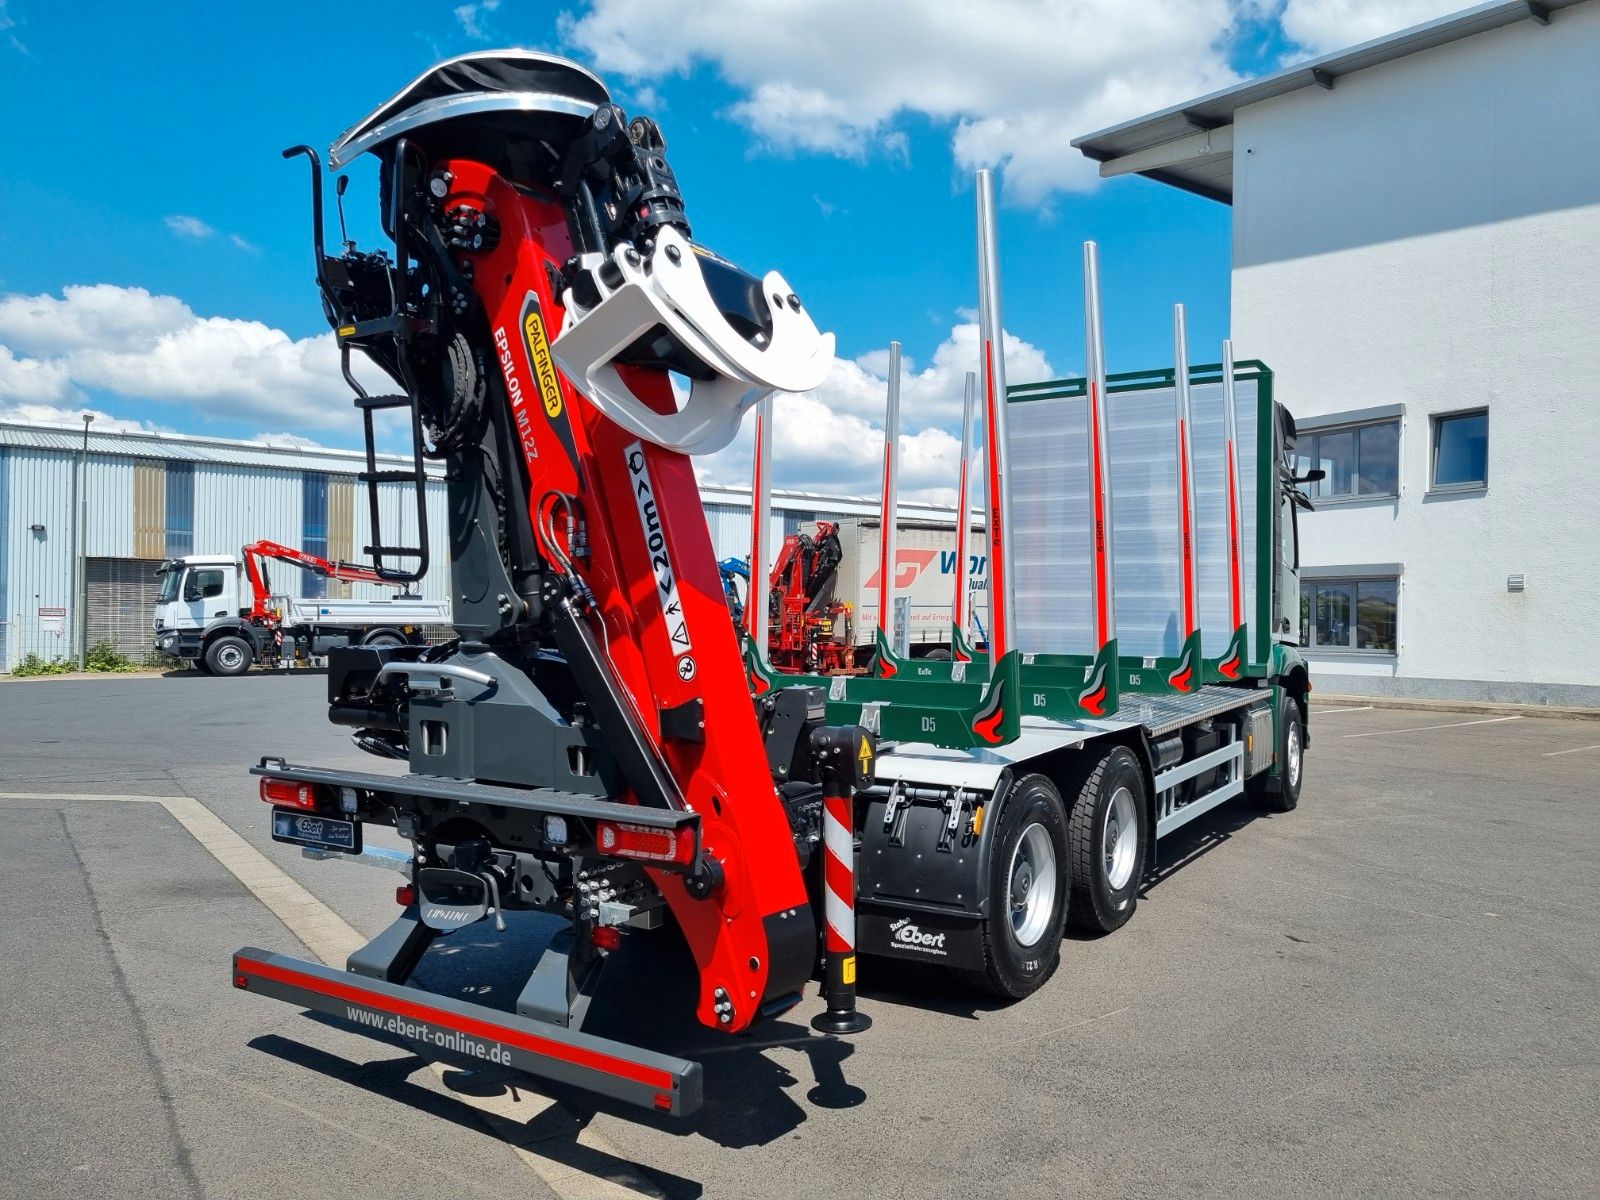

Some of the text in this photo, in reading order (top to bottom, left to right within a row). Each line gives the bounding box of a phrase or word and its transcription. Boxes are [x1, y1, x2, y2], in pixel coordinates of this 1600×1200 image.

[528, 318, 559, 411] PALFINGER
[494, 326, 539, 463] EPSILON M12Z
[1129, 674, 1141, 686] D5
[1033, 693, 1046, 707] D5
[921, 716, 936, 733] D5
[900, 925, 946, 948] Ebert
[346, 1005, 512, 1067] www.ebert-online.de
